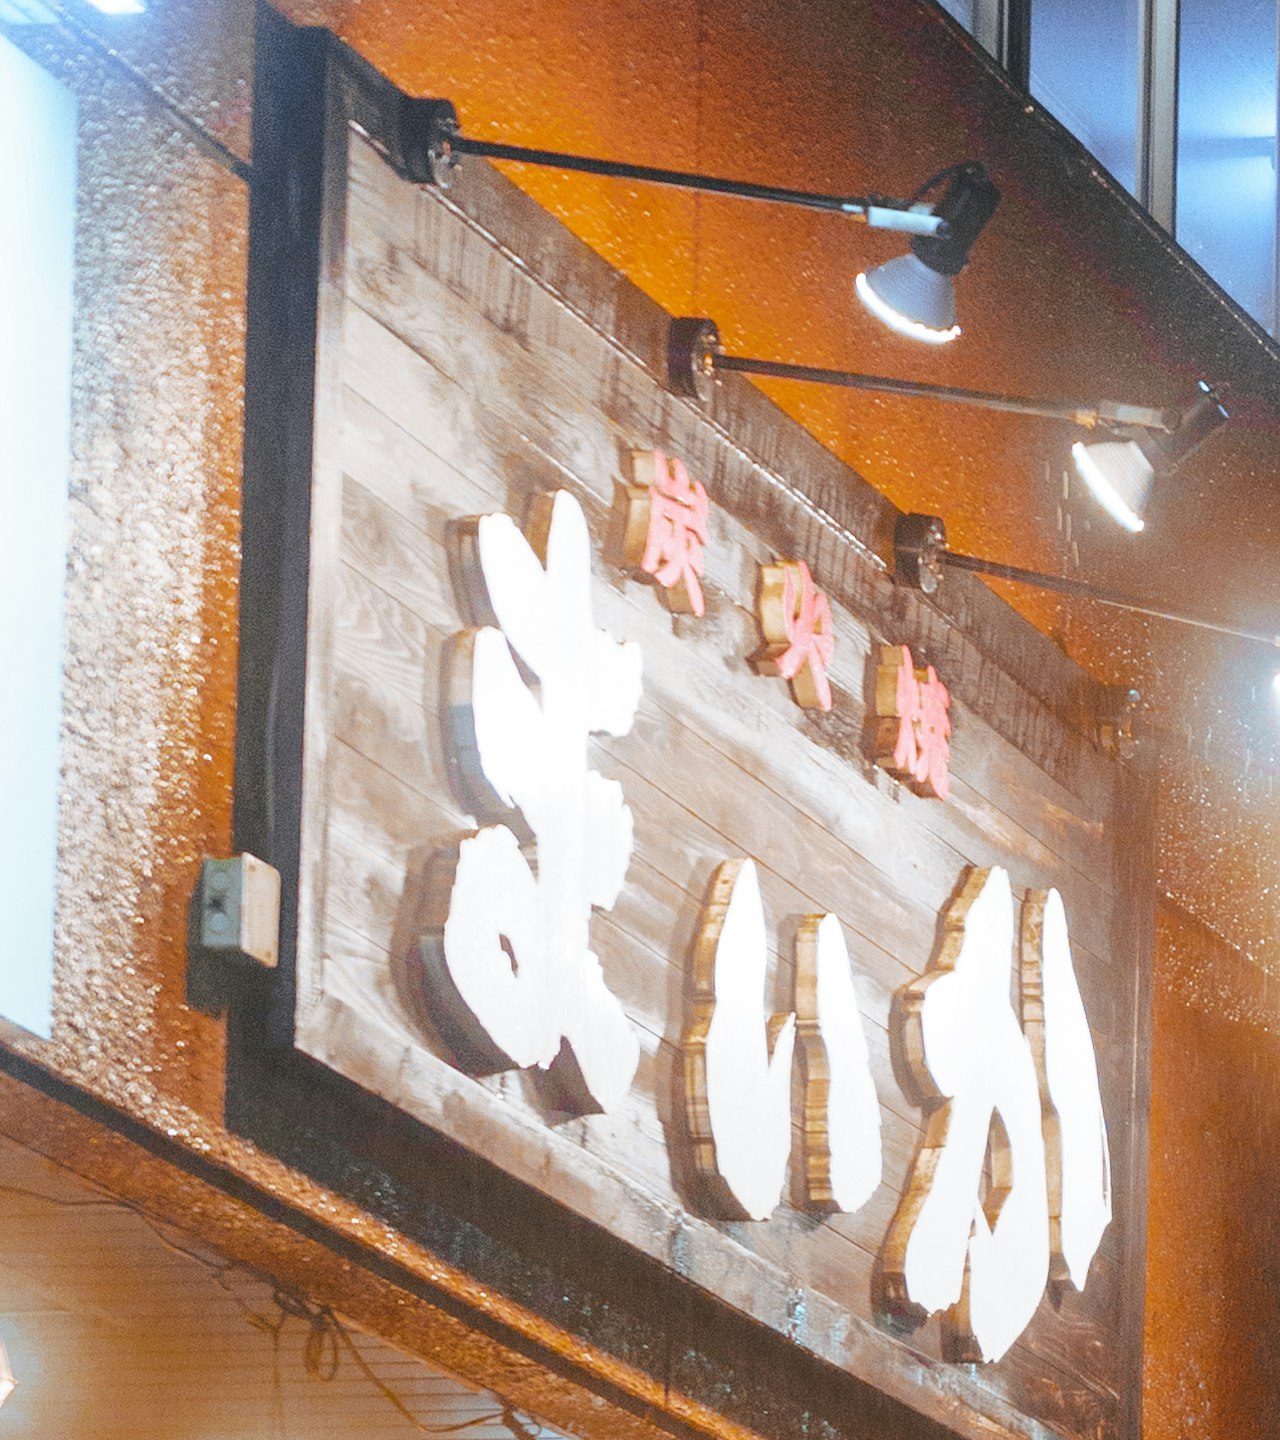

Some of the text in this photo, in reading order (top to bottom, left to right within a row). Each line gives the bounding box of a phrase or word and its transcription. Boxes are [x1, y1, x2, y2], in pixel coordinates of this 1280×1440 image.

[444, 488, 1112, 1363] まいか
[640, 446, 952, 800] 炭火焼
